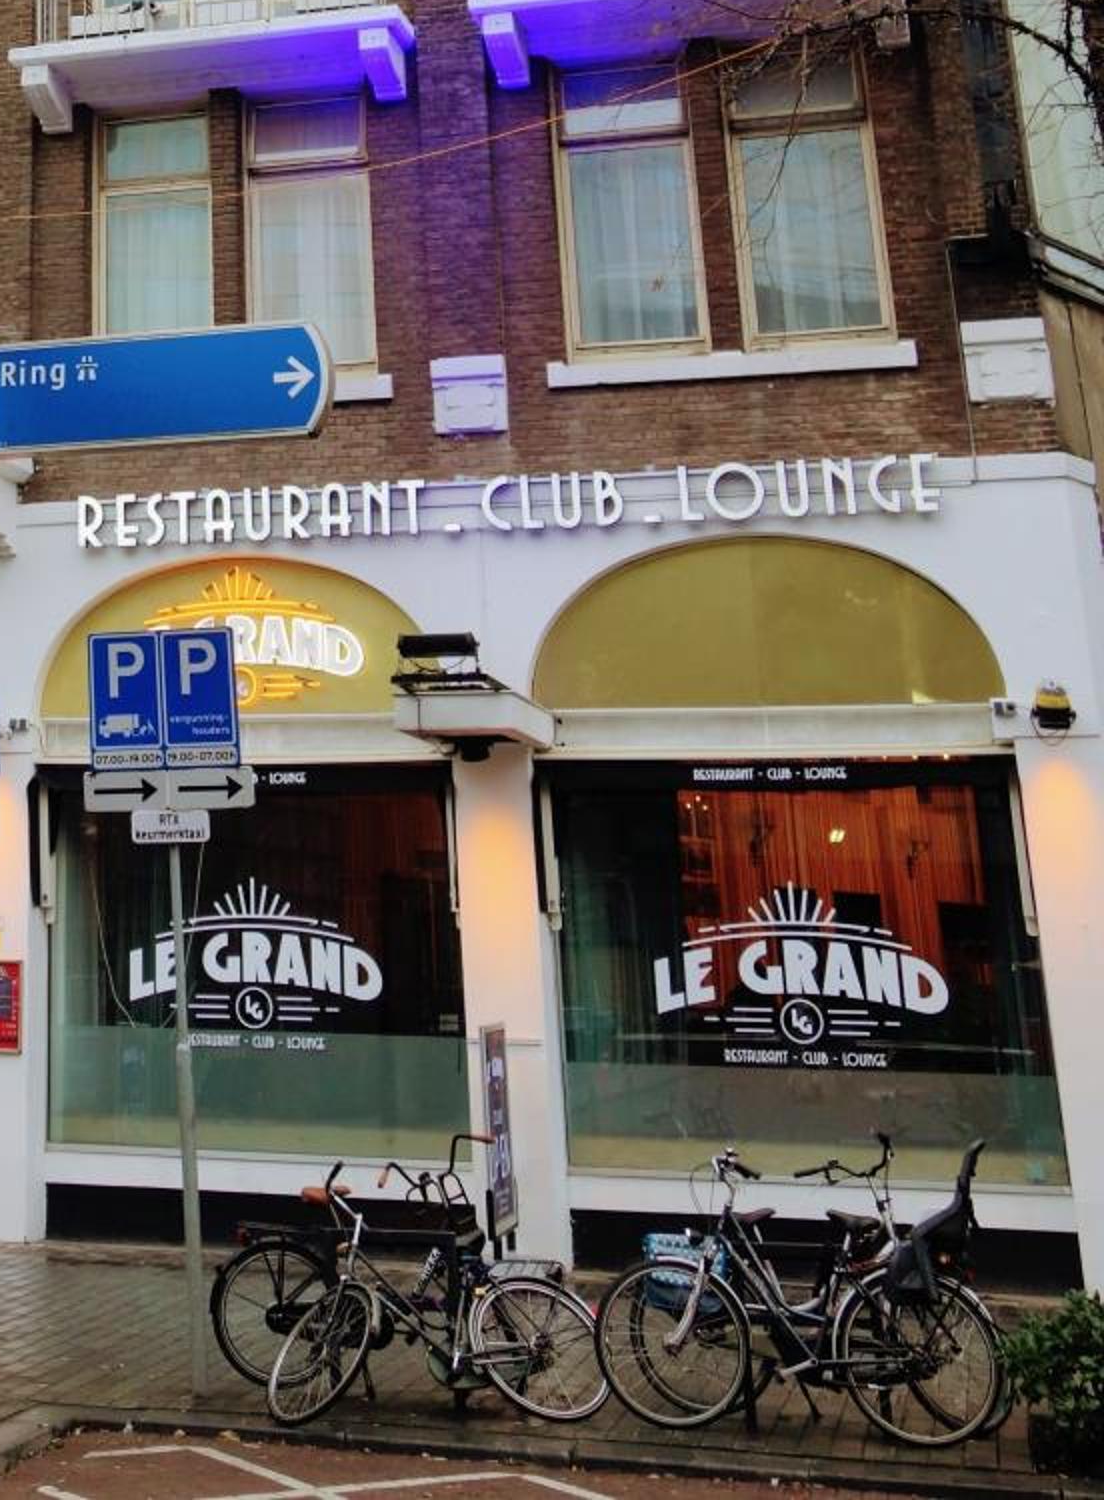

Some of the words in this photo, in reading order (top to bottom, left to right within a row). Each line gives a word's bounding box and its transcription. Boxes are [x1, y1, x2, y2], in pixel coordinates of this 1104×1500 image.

[0, 359, 65, 390] Ring
[77, 479, 425, 549] RESTAURANT
[481, 471, 623, 531] CLUB
[677, 453, 941, 522] LOUNGE
[107, 642, 144, 699] P
[178, 638, 216, 695] P
[195, 614, 365, 677] RAND
[693, 767, 754, 781] RESTAURANT
[767, 767, 793, 780] CLUB
[804, 766, 847, 780] LOUNGE
[129, 940, 180, 1001] LE
[202, 931, 383, 1001] GRAND
[654, 947, 716, 1014] LE
[738, 939, 949, 1014] GRAND
[251, 1035, 275, 1049] CLUB
[287, 1036, 326, 1050] LOUNGE
[724, 1049, 789, 1064] RESTAURANT
[802, 1051, 829, 1065] CLUB
[843, 1052, 888, 1067] LOUNGE
